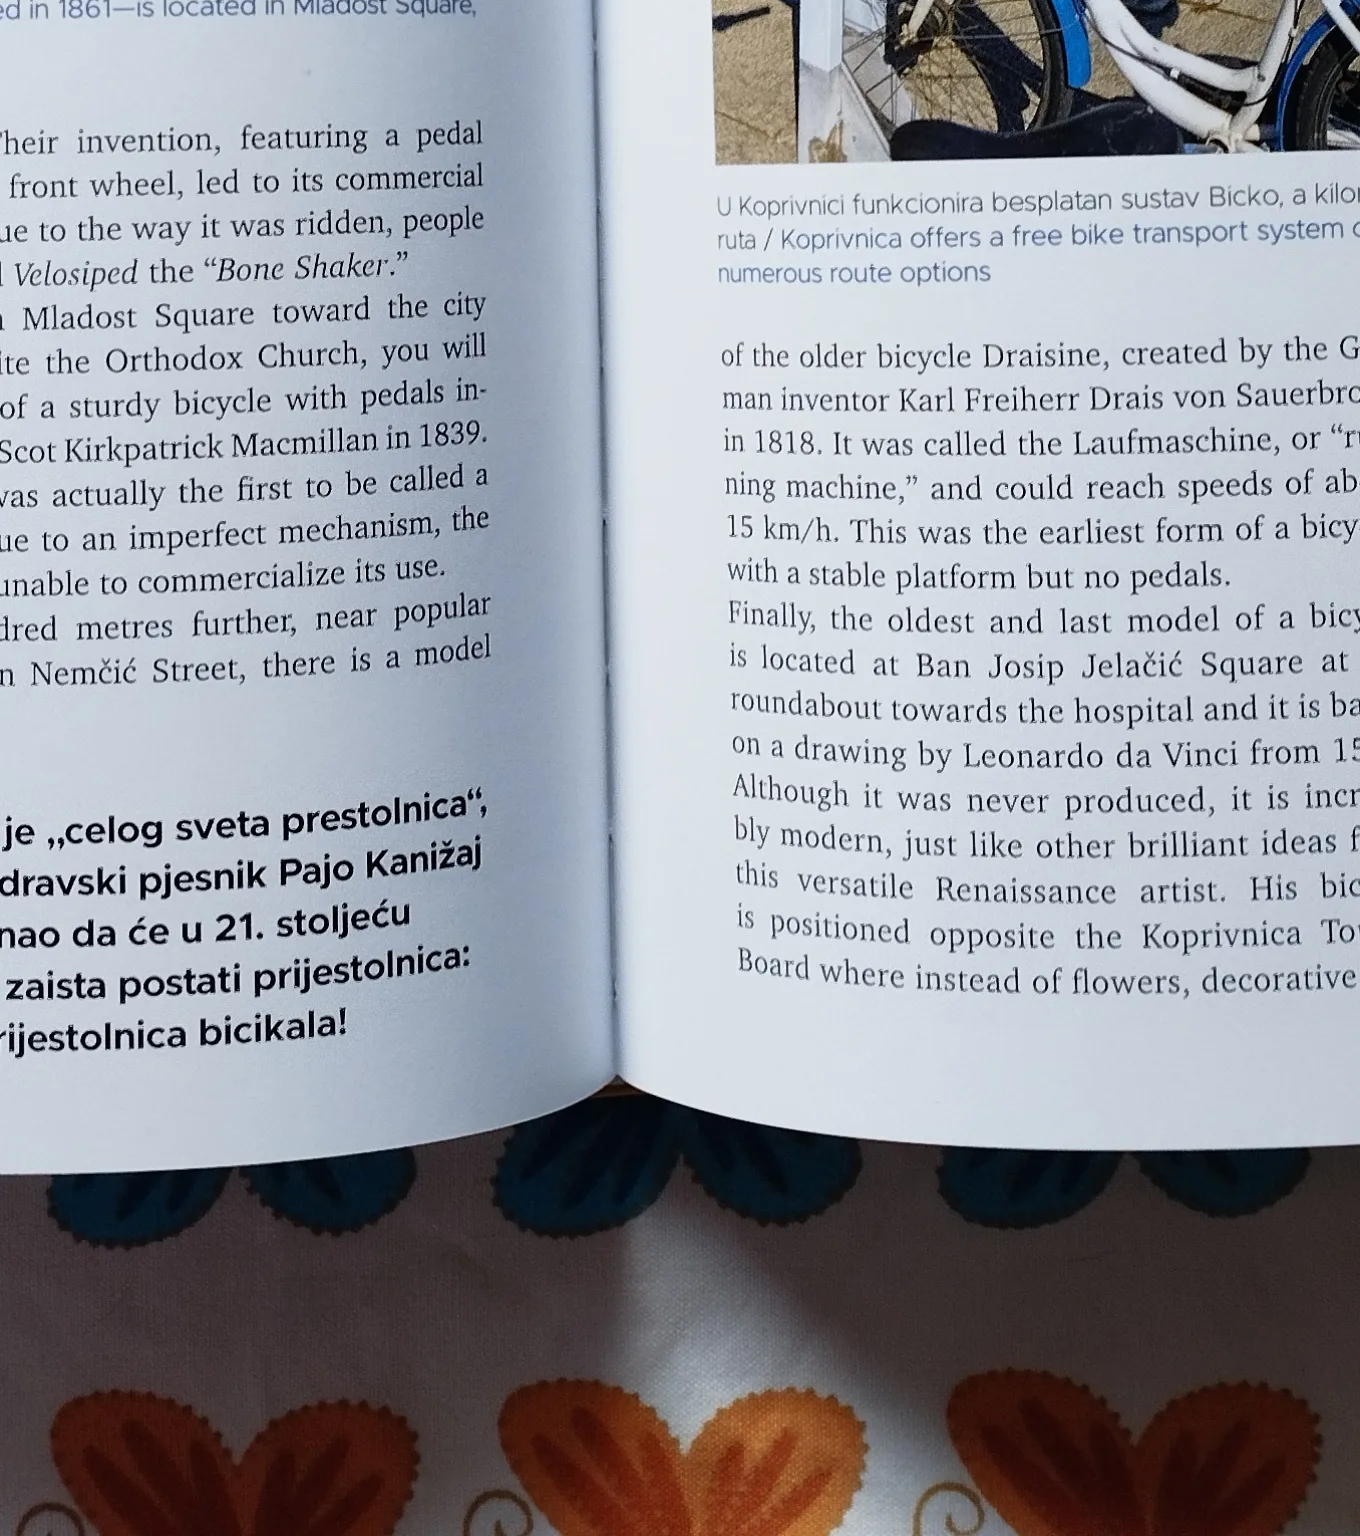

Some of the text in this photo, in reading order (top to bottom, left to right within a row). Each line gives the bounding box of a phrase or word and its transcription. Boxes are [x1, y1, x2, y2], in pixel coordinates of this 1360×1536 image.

[717, 196, 732, 217] U
[739, 195, 845, 221] Koprivnici
[852, 191, 984, 216] funkcionira
[992, 189, 1112, 217] besplatan
[1121, 187, 1200, 211] sustav
[1209, 183, 1284, 209] Bicko,
[1292, 187, 1307, 206] a
[718, 260, 992, 288] numerous route options
[64, 431, 225, 469] Kirkpatrick
[230, 426, 380, 459] Macmillan
[385, 424, 412, 451] in
[419, 419, 488, 449] 1839.
[729, 641, 747, 669] is
[760, 642, 856, 676] located
[872, 655, 900, 677] at
[915, 652, 972, 679] Ban
[988, 652, 1064, 687] Josip
[1081, 649, 1184, 680] Jelačić
[1200, 650, 1304, 684] Square
[1321, 650, 1350, 674] at
[1, 814, 36, 853] je
[174, 810, 270, 842] sveta
[139, 858, 268, 902] pjesnik
[279, 852, 355, 891] Pajo
[366, 833, 482, 880] Kanižaj
[199, 1006, 347, 1047] bicikala!
